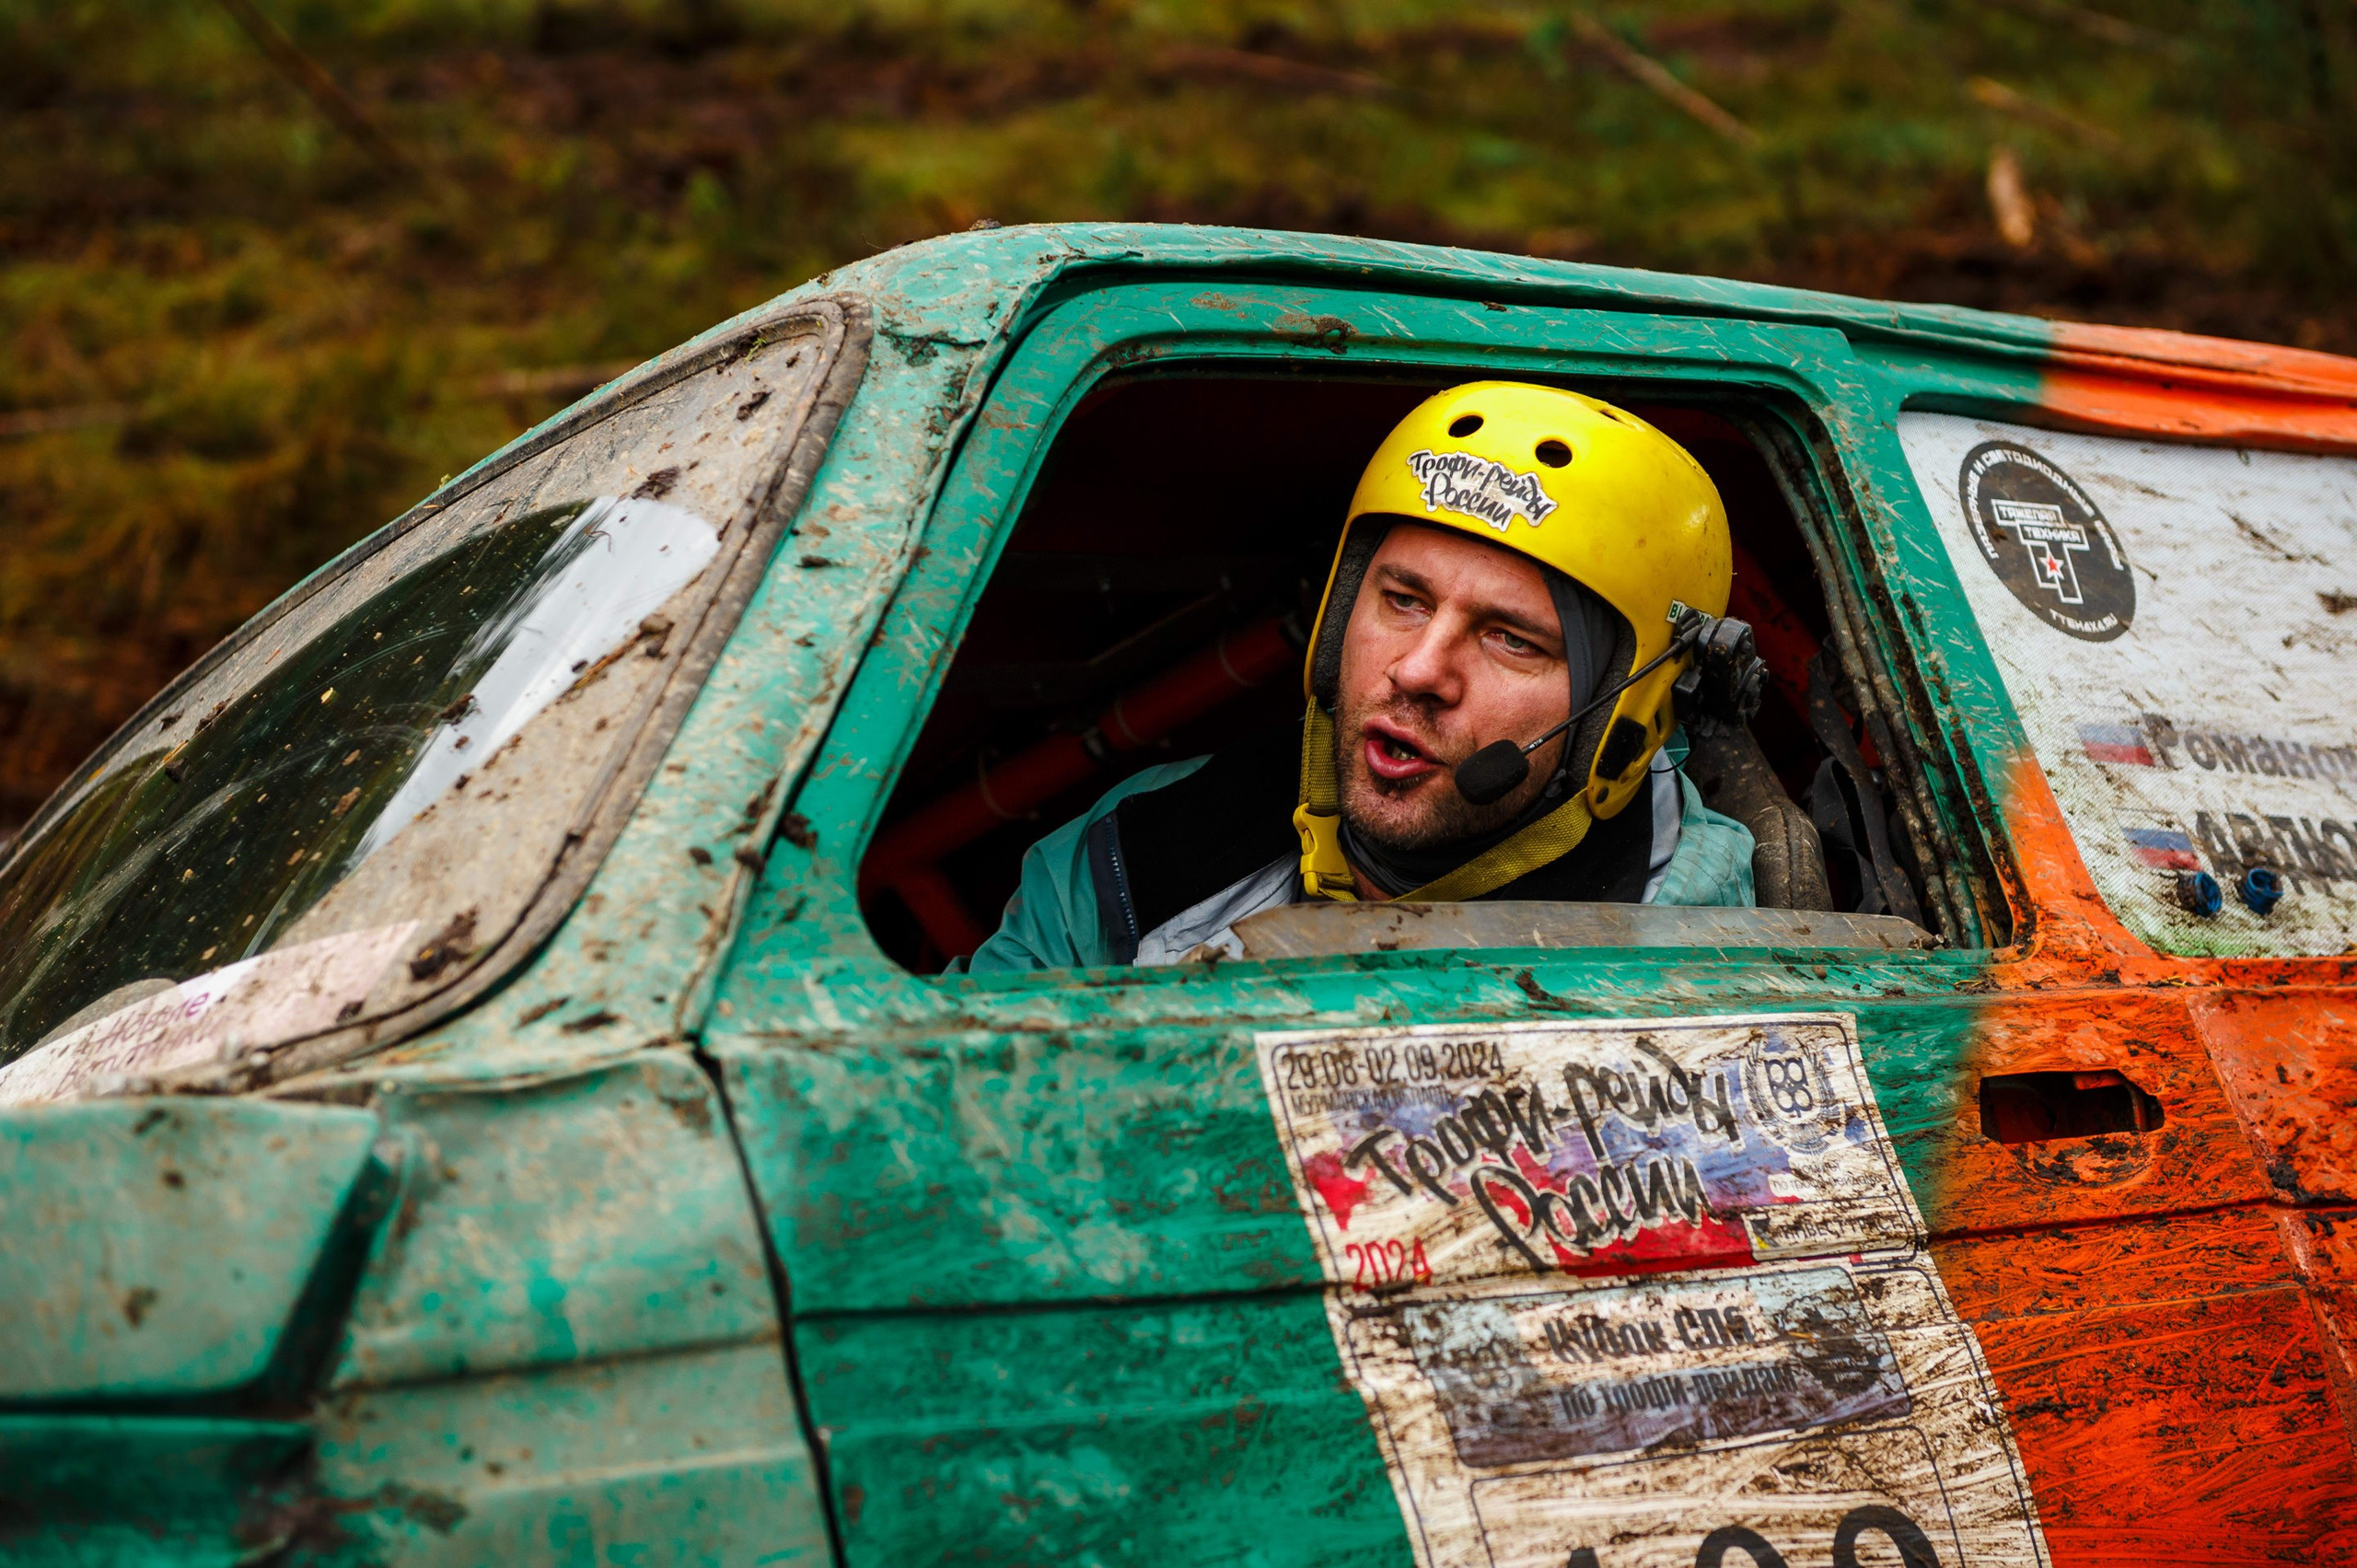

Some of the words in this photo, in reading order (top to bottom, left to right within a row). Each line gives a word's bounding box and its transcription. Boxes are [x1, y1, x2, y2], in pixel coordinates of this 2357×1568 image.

[1410, 452, 1552, 520] Трофи-рейды
[1425, 471, 1513, 528] России
[2024, 526, 2083, 543] ТЕХНИКА
[1344, 1037, 1742, 1205] Трофи-рейды
[1471, 1151, 1723, 1274] России
[1346, 1236, 1434, 1294] 2024
